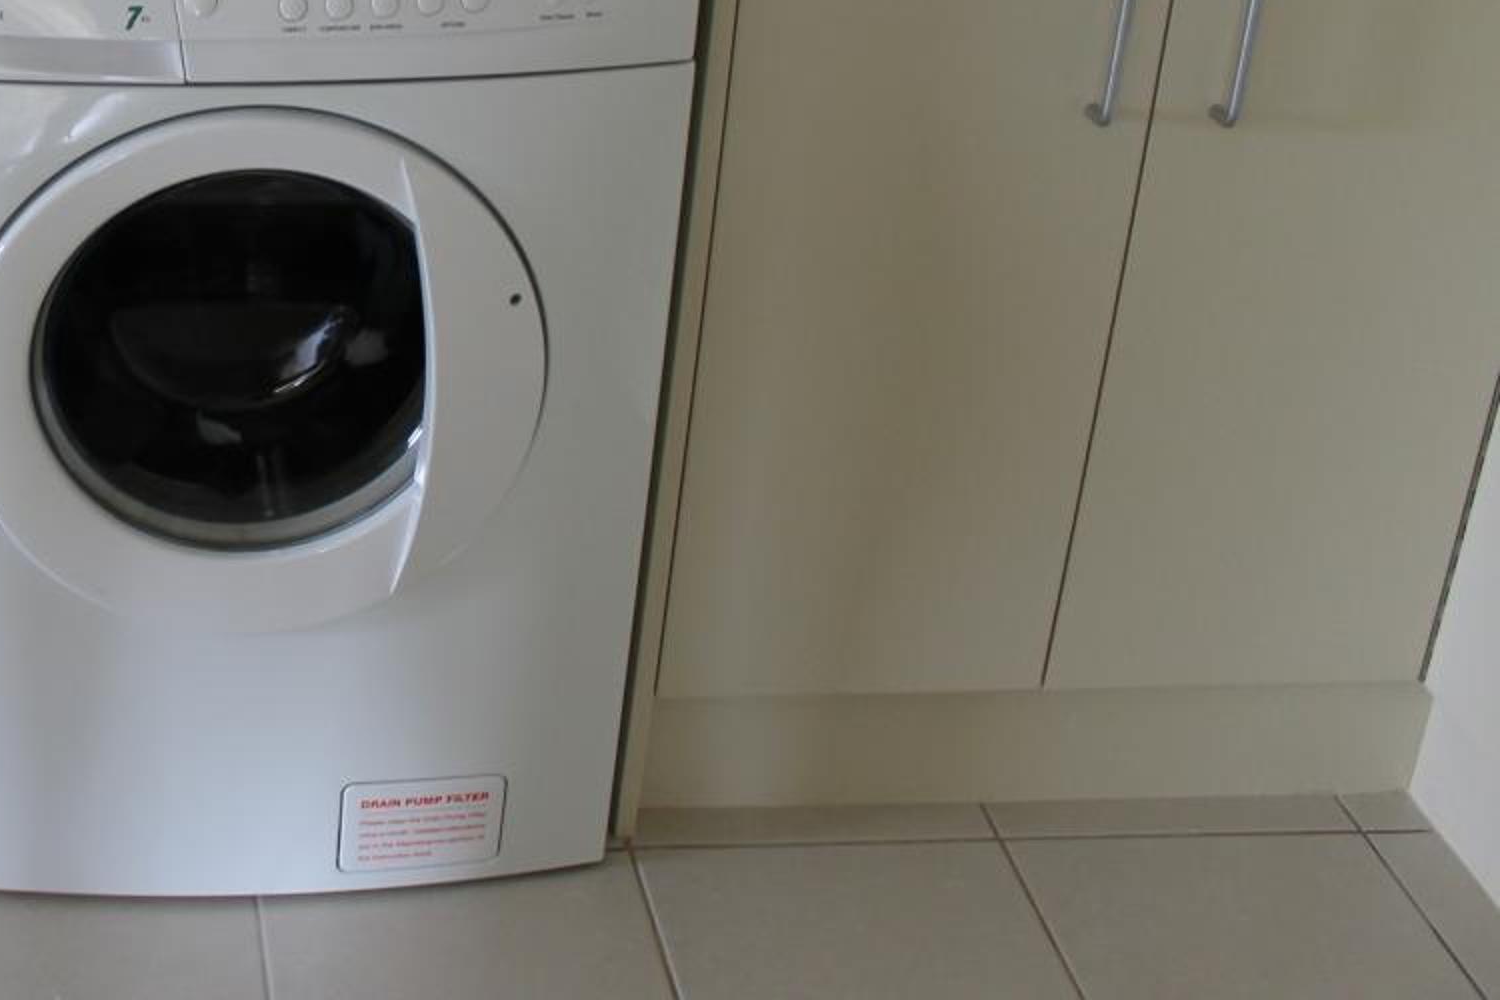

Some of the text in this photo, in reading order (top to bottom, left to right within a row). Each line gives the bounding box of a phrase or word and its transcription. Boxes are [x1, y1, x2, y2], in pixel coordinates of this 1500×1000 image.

[125, 4, 144, 31] 7
[360, 791, 490, 809] DRAIN PUMP FILTER
